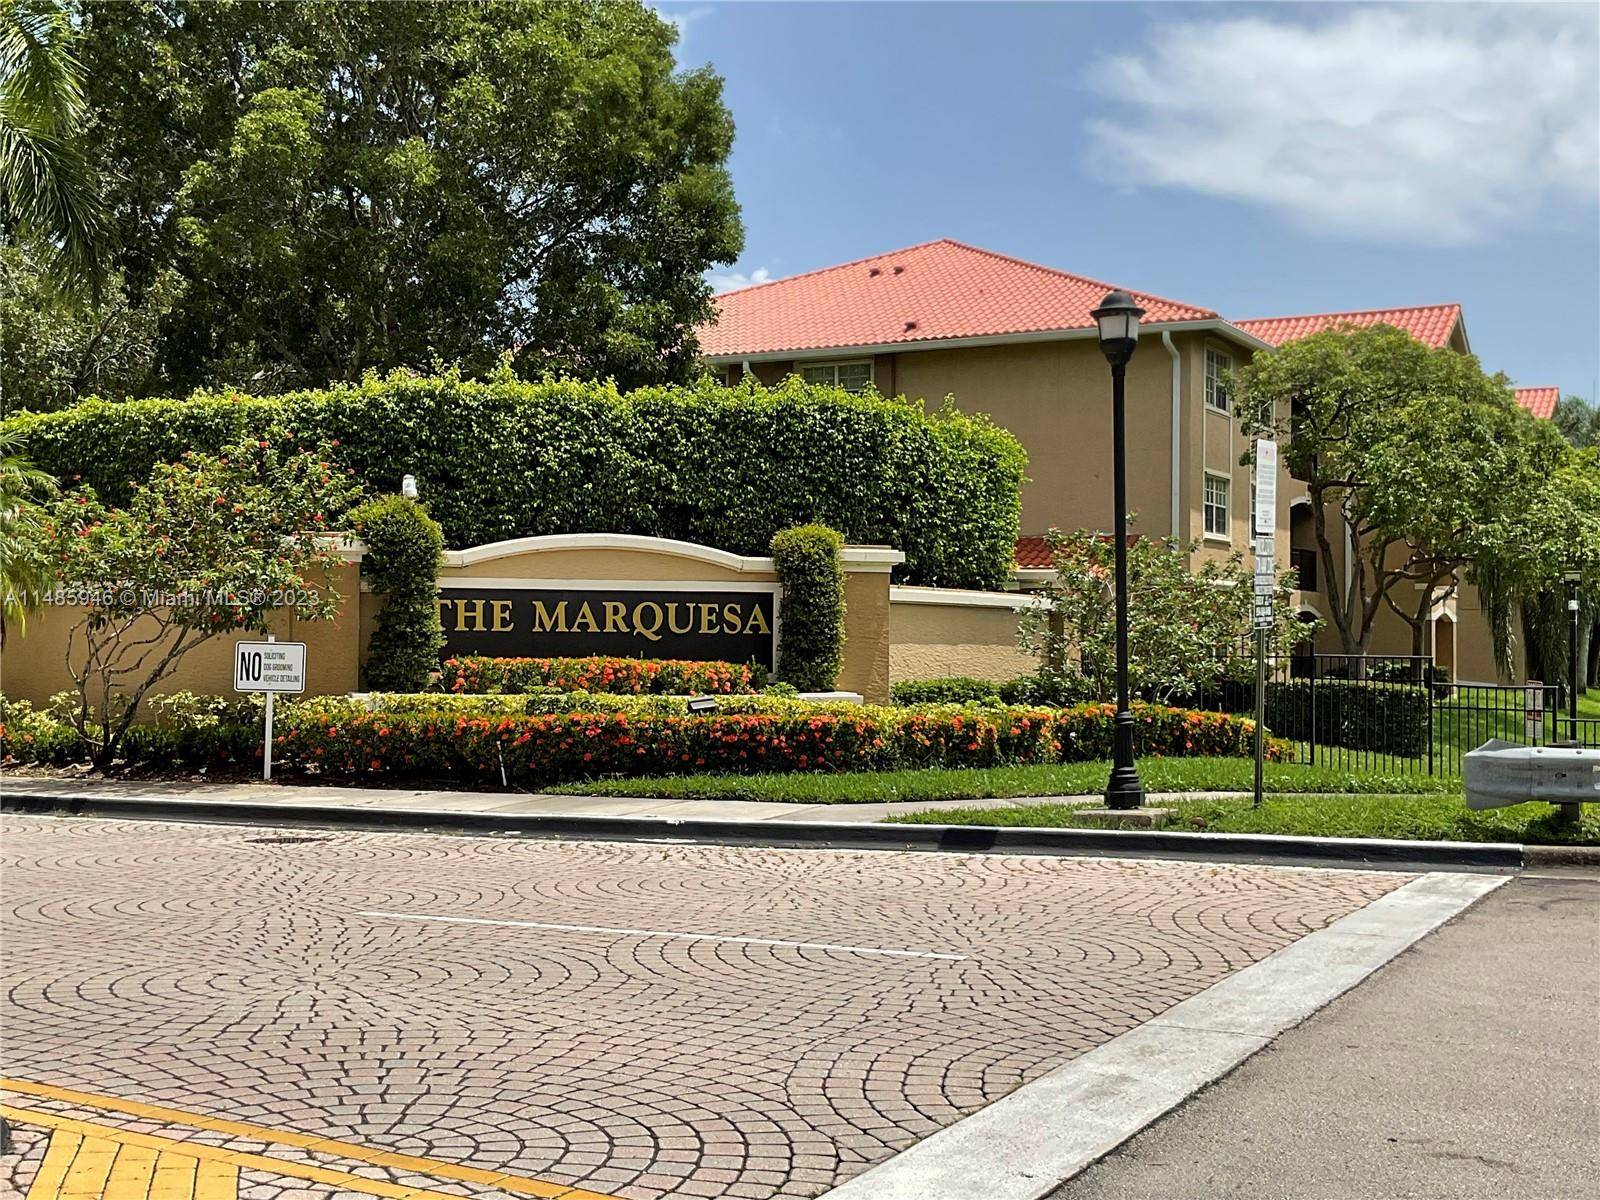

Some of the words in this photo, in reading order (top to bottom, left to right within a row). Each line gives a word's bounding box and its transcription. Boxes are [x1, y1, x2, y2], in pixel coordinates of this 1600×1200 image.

[433, 599, 514, 632] THE
[532, 600, 772, 641] MARQUESA
[264, 652, 286, 660] SOLICITING
[240, 651, 262, 681] NO
[263, 663, 272, 671] DOG
[263, 674, 279, 683] VEHICLE
[279, 674, 300, 683] DETAILING
